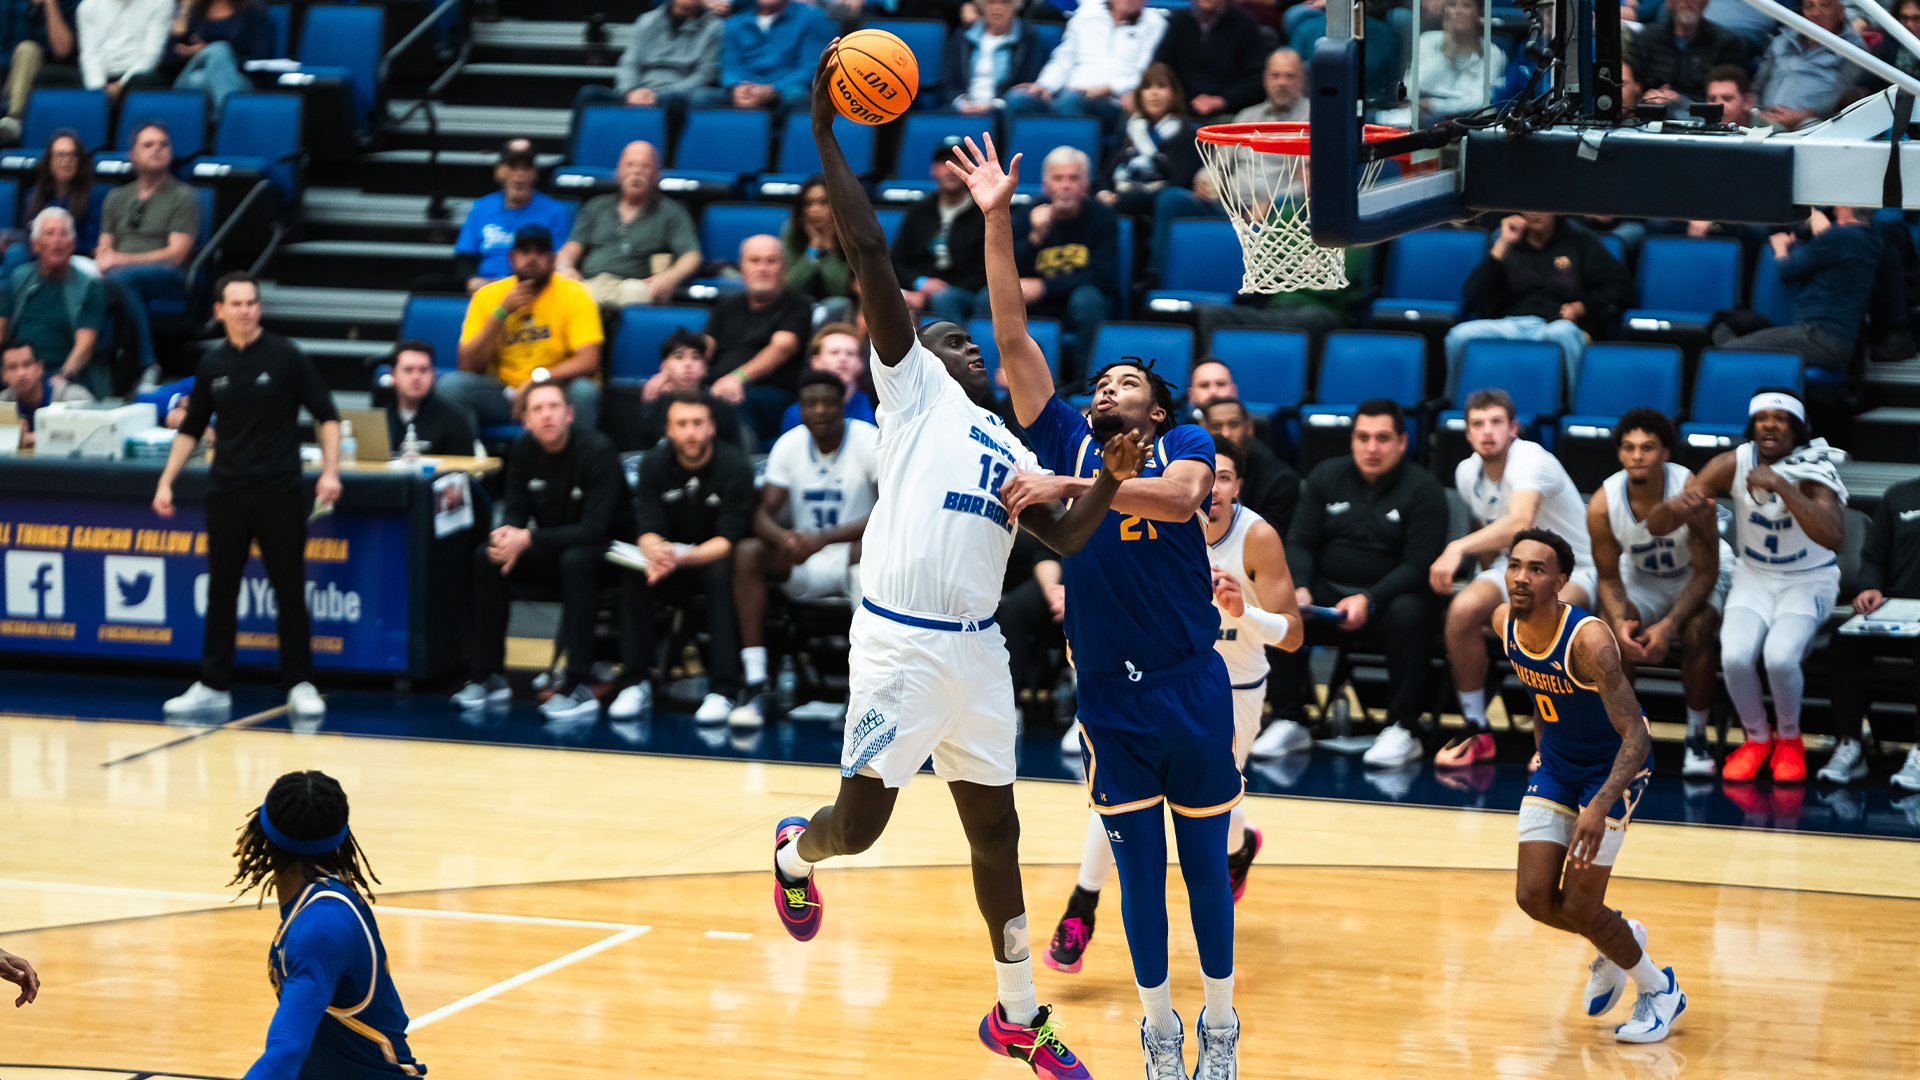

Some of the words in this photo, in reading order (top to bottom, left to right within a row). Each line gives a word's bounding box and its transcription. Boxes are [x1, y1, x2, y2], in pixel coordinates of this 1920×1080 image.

[836, 77, 884, 123] Wilson
[969, 425, 1017, 464] SANTA
[1535, 693, 1559, 722] 0
